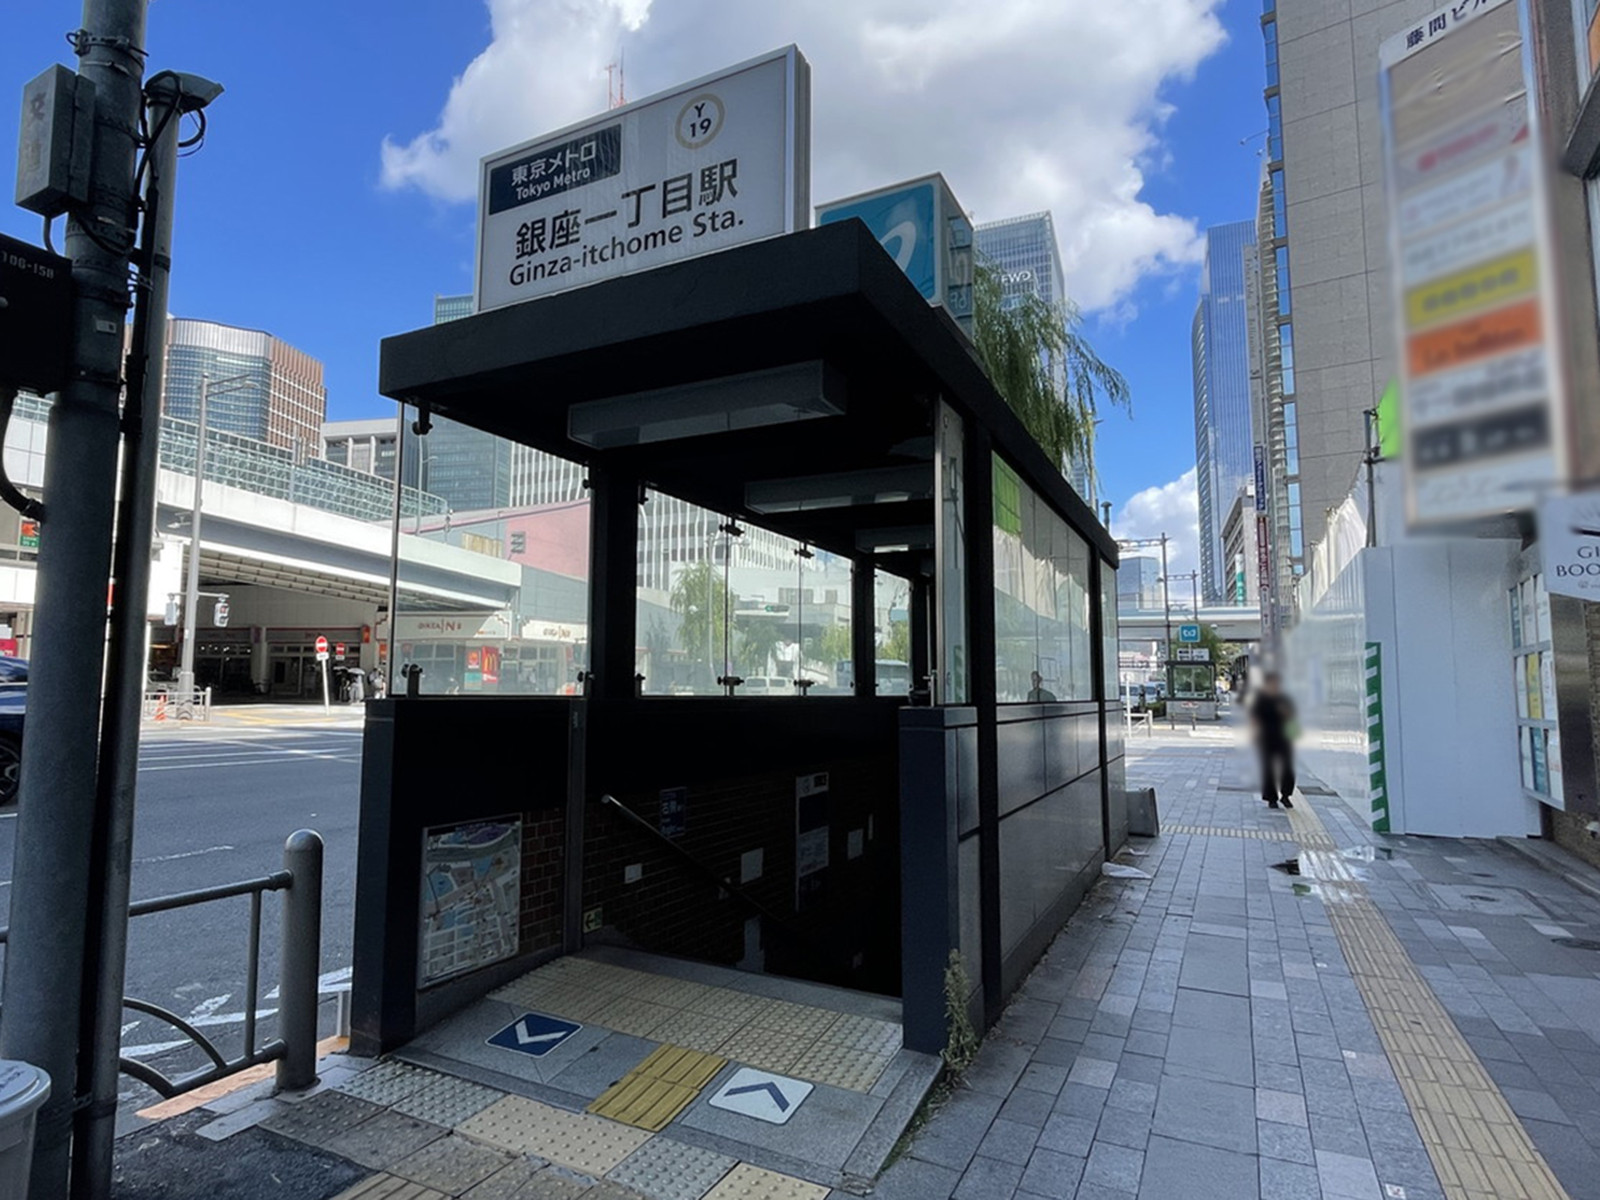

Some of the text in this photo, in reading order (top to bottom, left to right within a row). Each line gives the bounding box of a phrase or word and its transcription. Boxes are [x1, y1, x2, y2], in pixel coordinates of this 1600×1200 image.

[689, 118, 712, 138] 19
[693, 103, 705, 118] Y
[512, 141, 596, 187] 東京メトロ
[516, 166, 591, 200] Tokyo Metro
[516, 158, 738, 260] 銀座一丁目駅
[509, 207, 744, 287] Ginza-itchome Sta.
